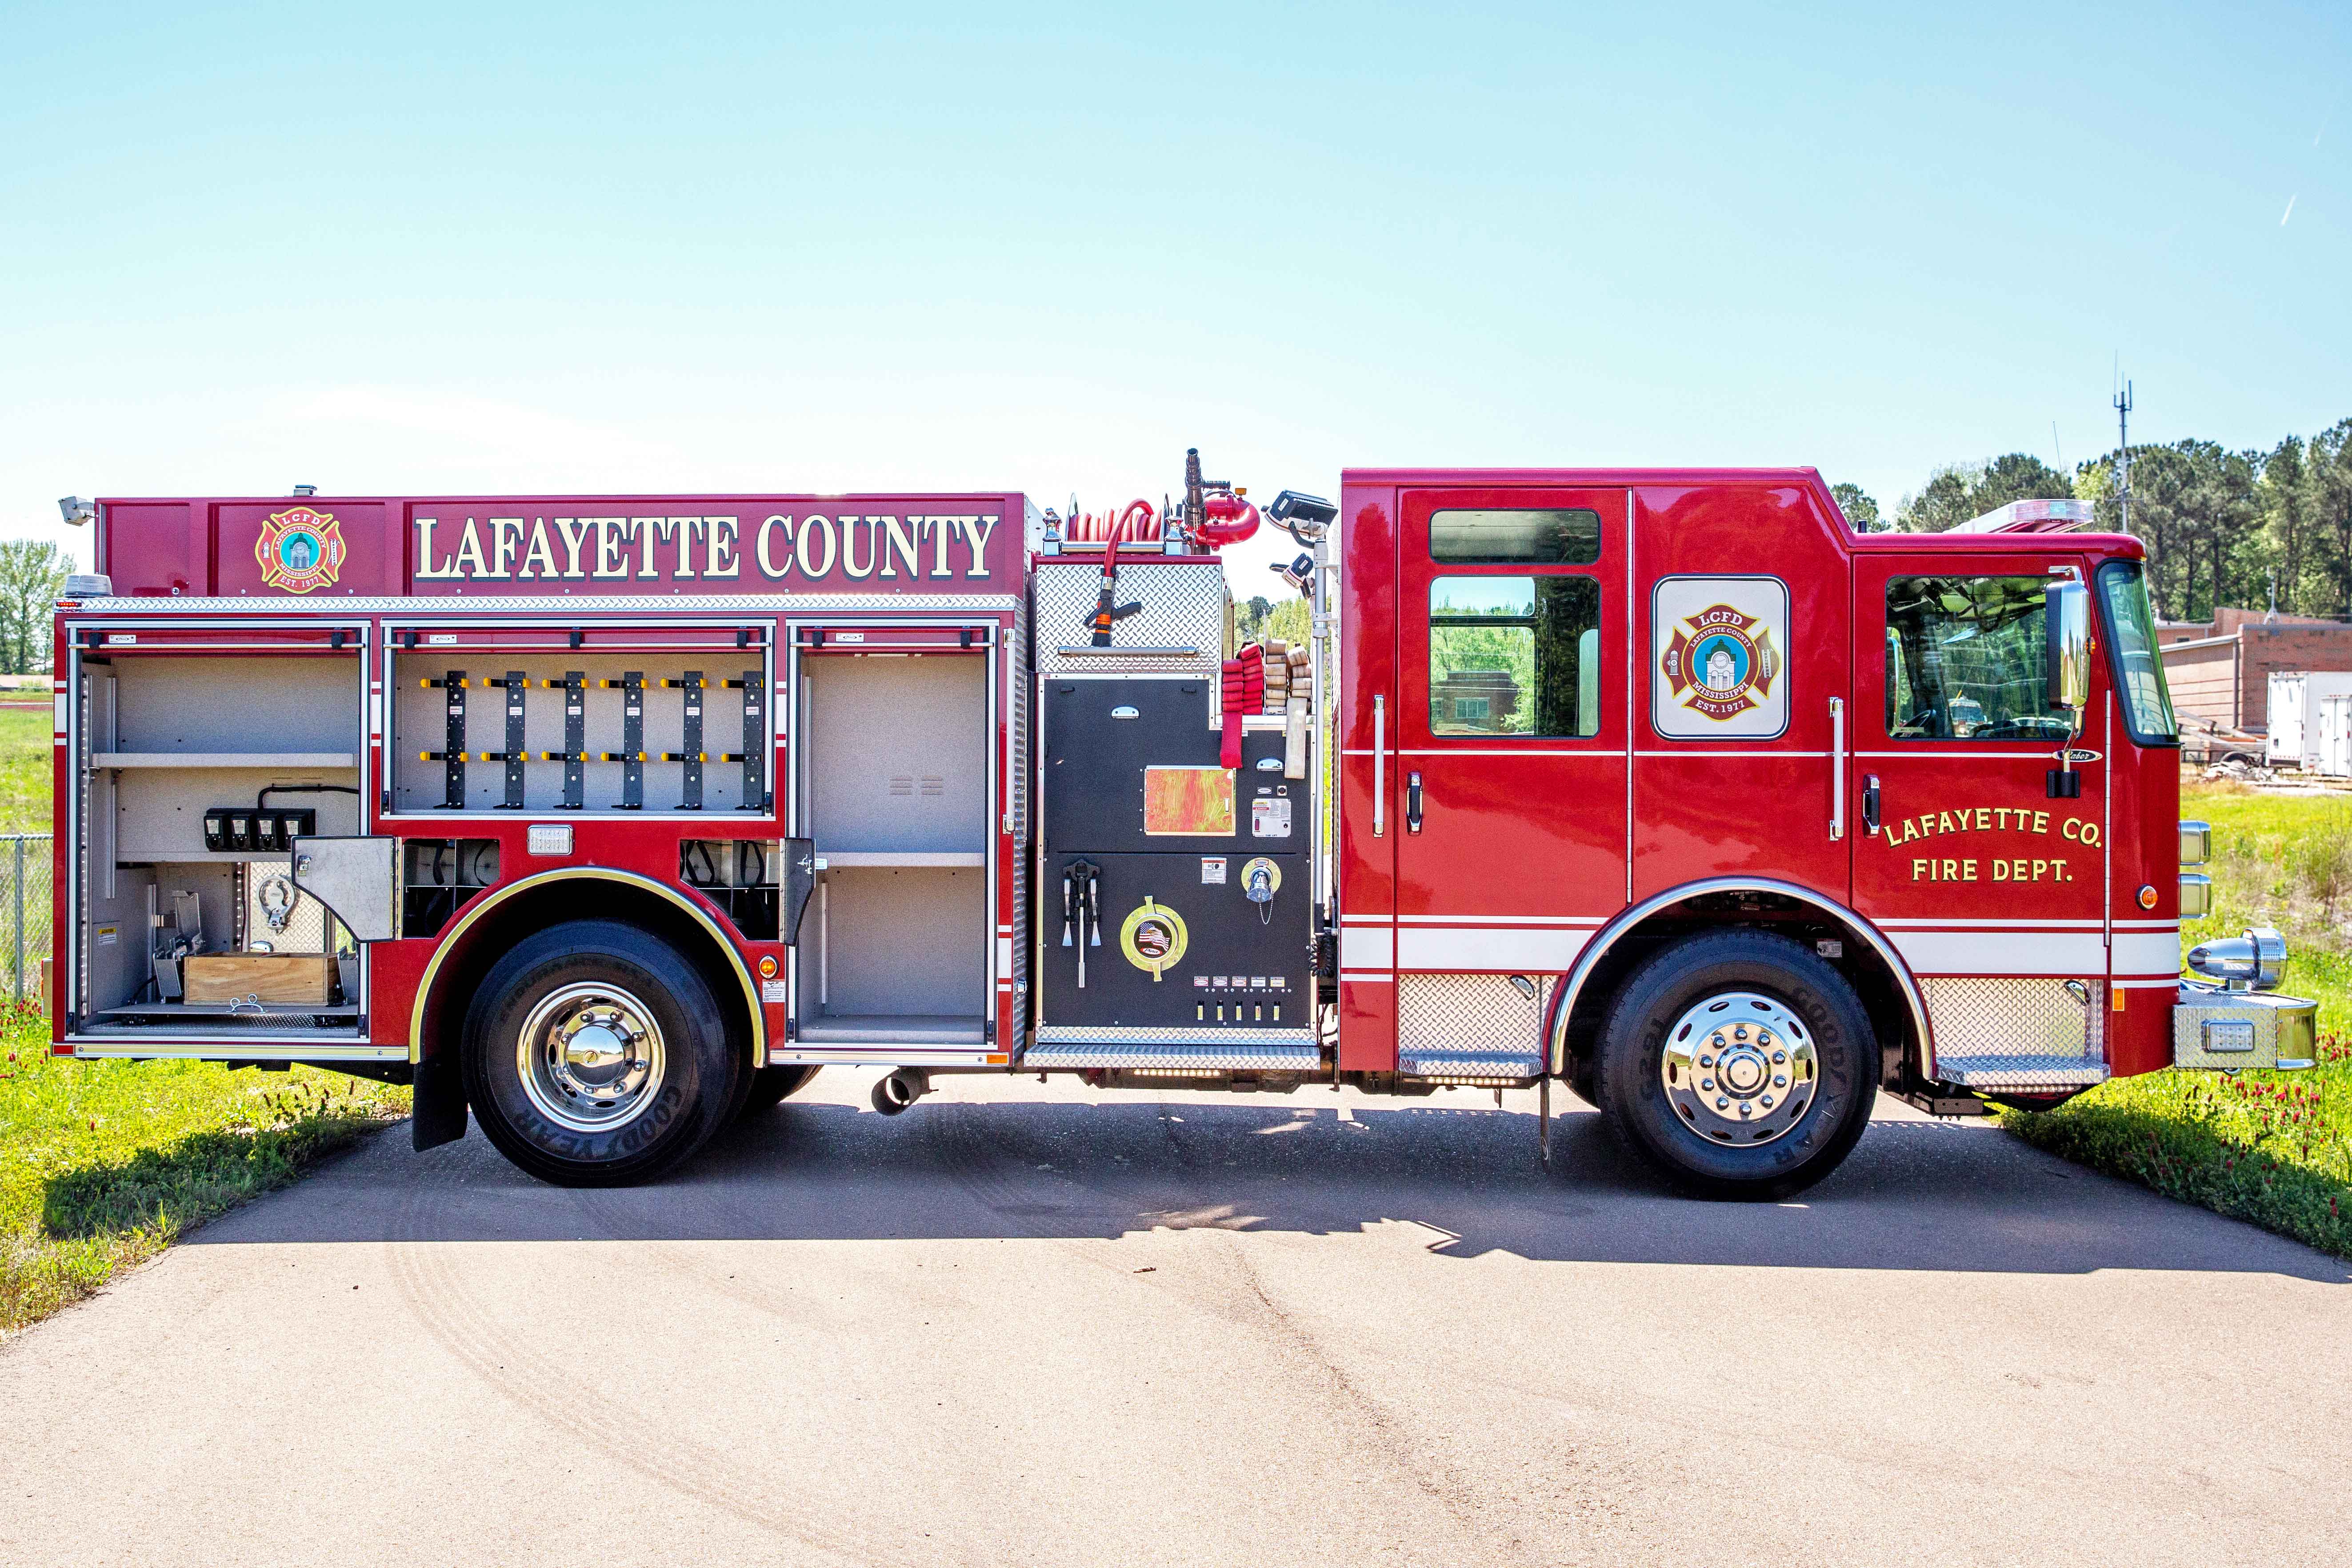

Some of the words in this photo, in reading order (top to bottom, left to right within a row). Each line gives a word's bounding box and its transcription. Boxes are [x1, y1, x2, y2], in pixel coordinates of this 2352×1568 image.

[282, 514, 320, 525] LCFD
[275, 526, 307, 550] LAFAYETTE
[307, 527, 327, 548] COUNTY
[415, 516, 740, 580] LAFAYETTE
[756, 515, 999, 579] COUNTY
[279, 563, 320, 577] MISSISSIPPI
[280, 576, 297, 587] EST.
[302, 576, 319, 588] 1977
[1699, 611, 1743, 626] LCFD
[1690, 627, 1725, 648] LAFAYETTE
[1727, 628, 1752, 648] COUNTY
[1692, 681, 1749, 700] MISSISSIPPI
[1695, 700, 1719, 713] EST.
[1721, 700, 1745, 713] 1977
[1883, 808, 2050, 848] LAFAYETTE
[2062, 817, 2102, 848] CO.
[1912, 859, 1978, 882] FIRE
[1992, 859, 2073, 882] DEPT.
